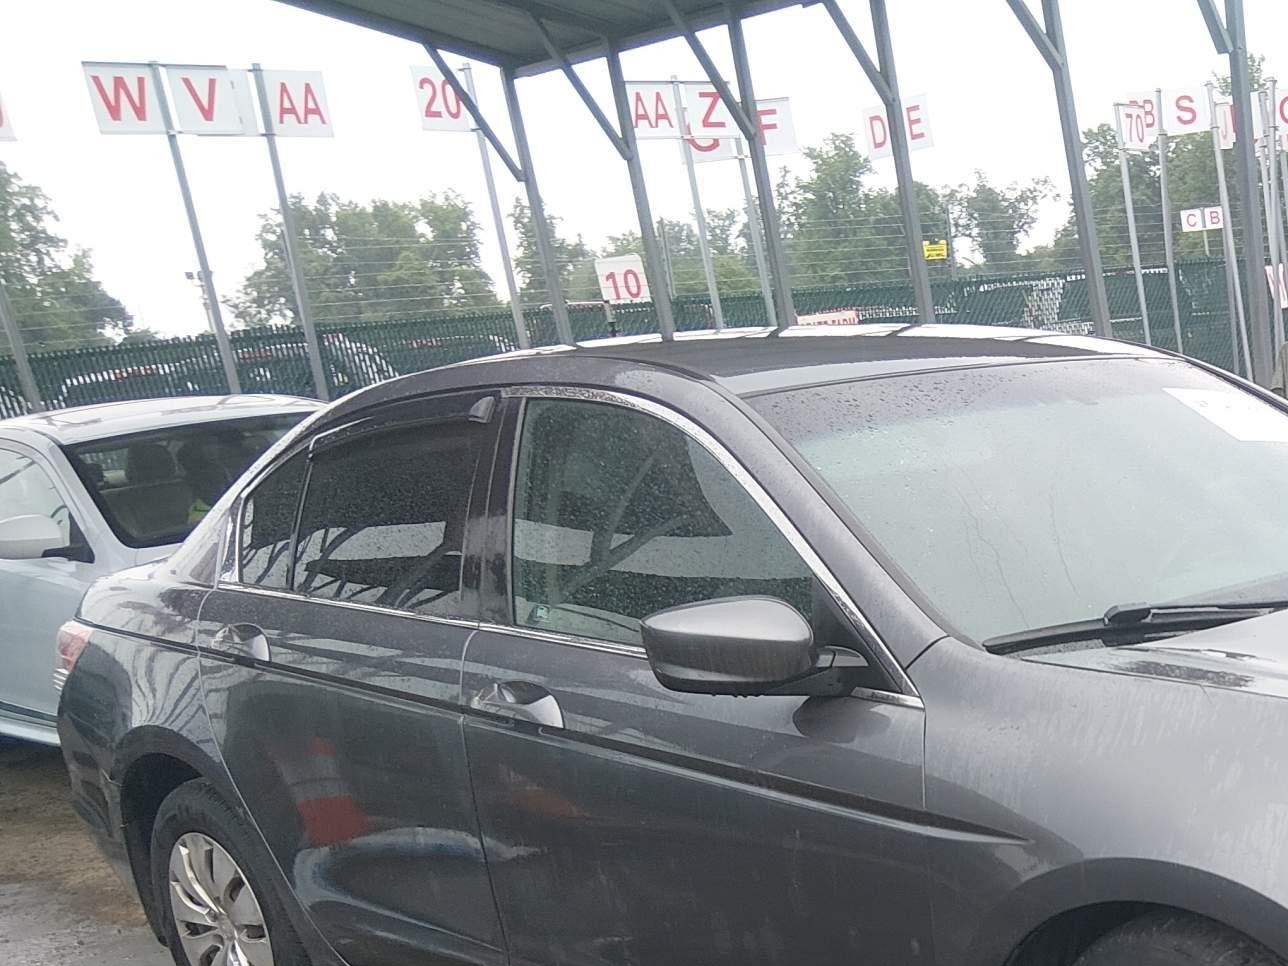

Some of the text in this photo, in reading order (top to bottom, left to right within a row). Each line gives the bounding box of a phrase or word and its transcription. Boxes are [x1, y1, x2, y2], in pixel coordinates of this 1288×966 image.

[90, 75, 148, 122] W
[181, 77, 217, 122] V
[278, 81, 327, 125] AA
[418, 77, 462, 119] 20
[633, 91, 673, 128] AA
[698, 91, 726, 128] Z
[1175, 95, 1197, 125] S
[756, 108, 778, 145] F
[868, 115, 888, 149] D
[906, 104, 925, 140] E
[1125, 113, 1145, 143] 70
[1186, 211, 1221, 228] C B
[605, 268, 642, 300] 10
